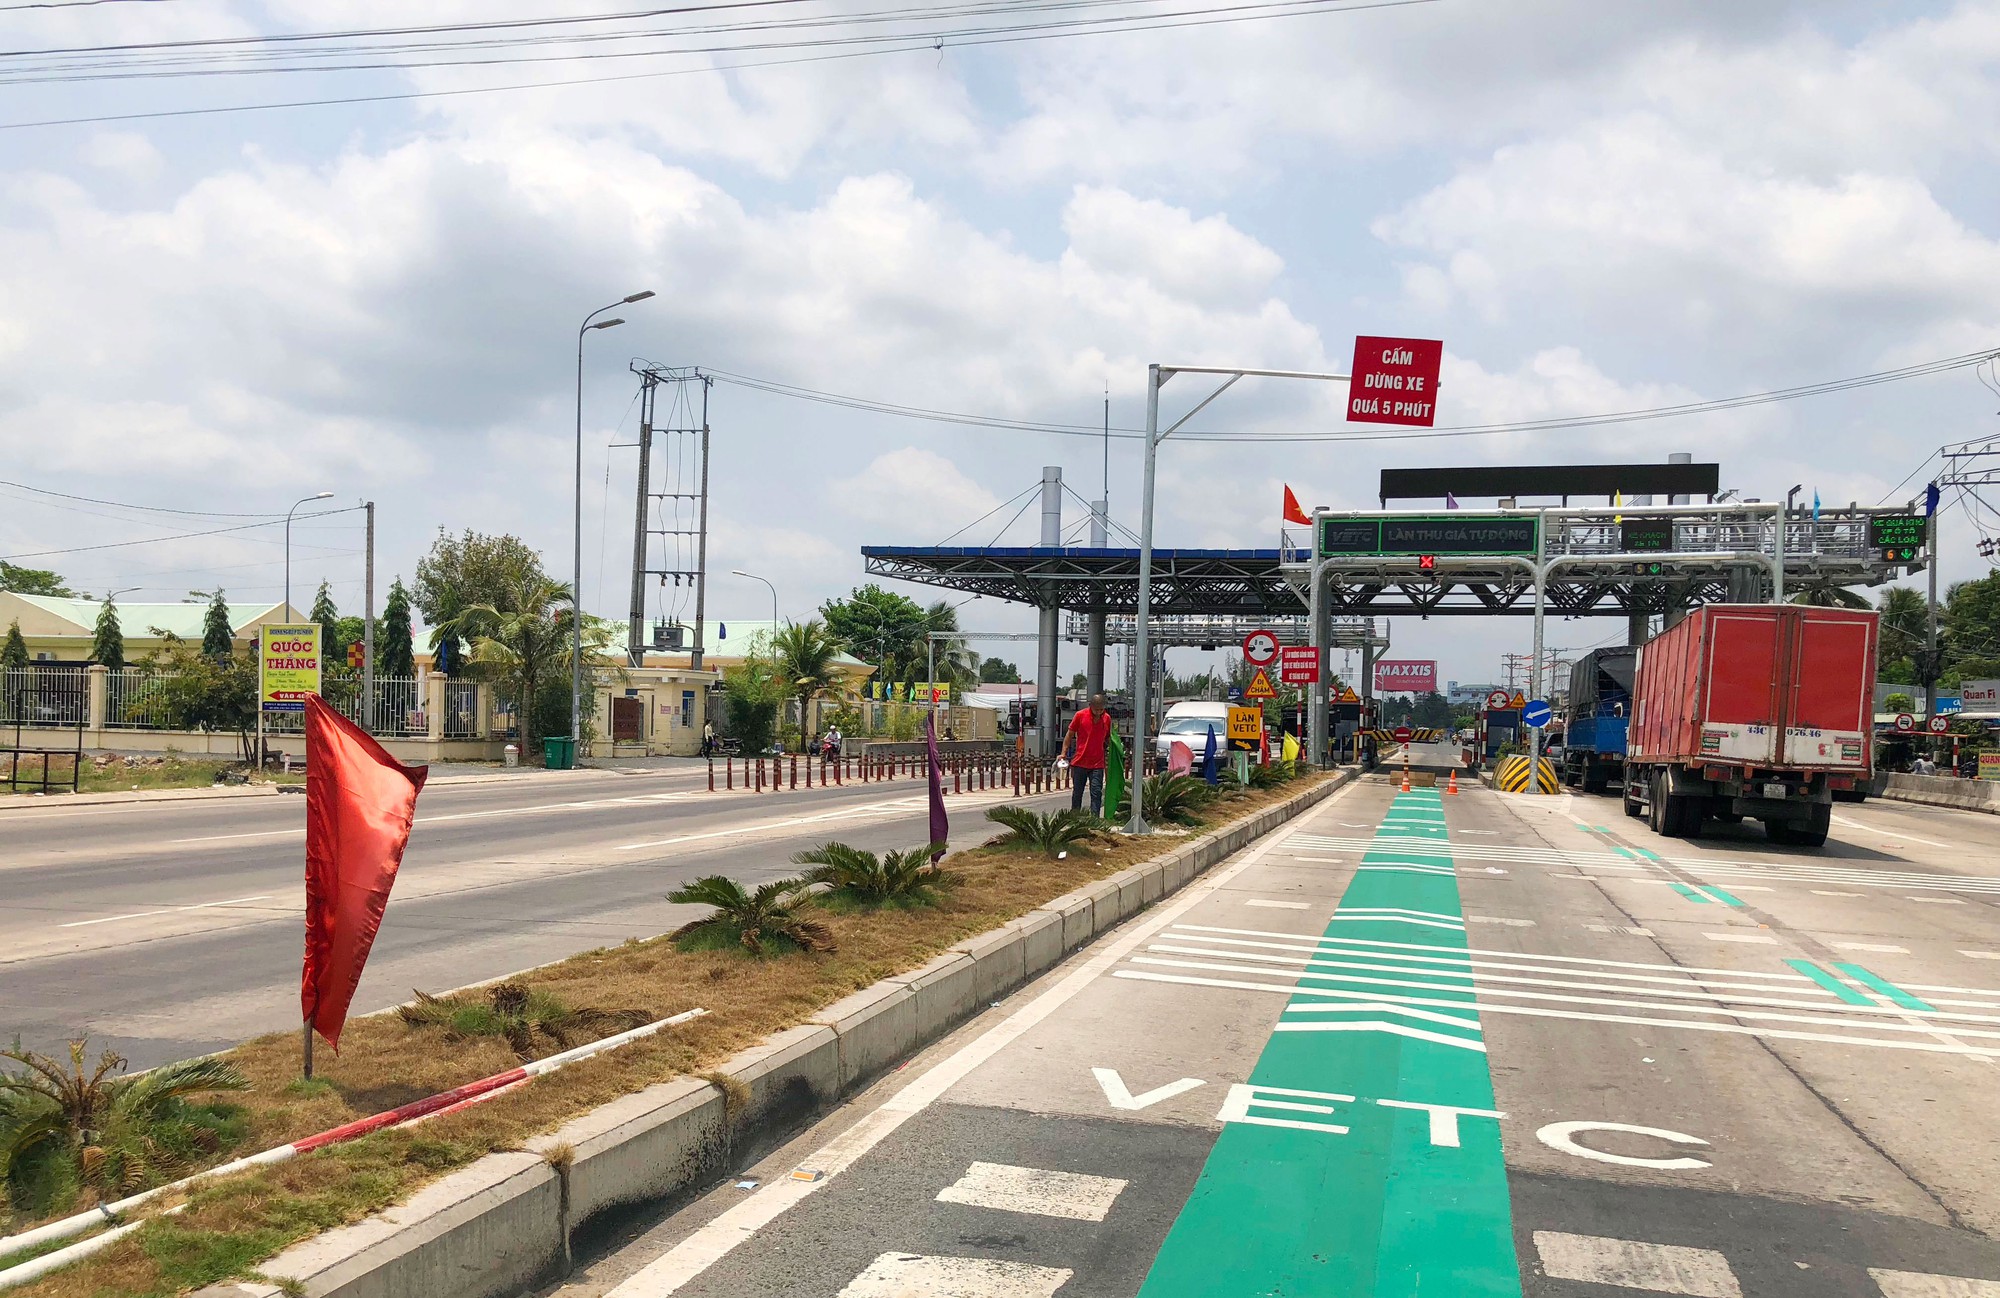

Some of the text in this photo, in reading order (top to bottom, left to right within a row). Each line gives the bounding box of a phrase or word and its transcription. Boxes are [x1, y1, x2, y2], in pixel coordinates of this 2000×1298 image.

[1382, 346, 1413, 365] CẤM
[1364, 372, 1424, 391] DỪNG XE
[1352, 398, 1431, 417] QUÁ 5 PHÚT
[1332, 530, 1372, 542] VETC
[1388, 528, 1414, 541] LÀN
[1416, 530, 1443, 541] THU
[1444, 528, 1468, 541] GIÁ
[1488, 528, 1528, 543] ĐỘNG
[1887, 550, 1894, 560] 6
[271, 637, 312, 653] QUỐC
[267, 654, 317, 669] THẮNG
[1380, 665, 1431, 676] MAXXIS
[1964, 689, 1996, 699] Quan Fi
[1236, 712, 1254, 722] LÀN
[1233, 724, 1256, 732] VETC
[1747, 726, 1767, 735] 43C
[1092, 1067, 1713, 1170] VETC
